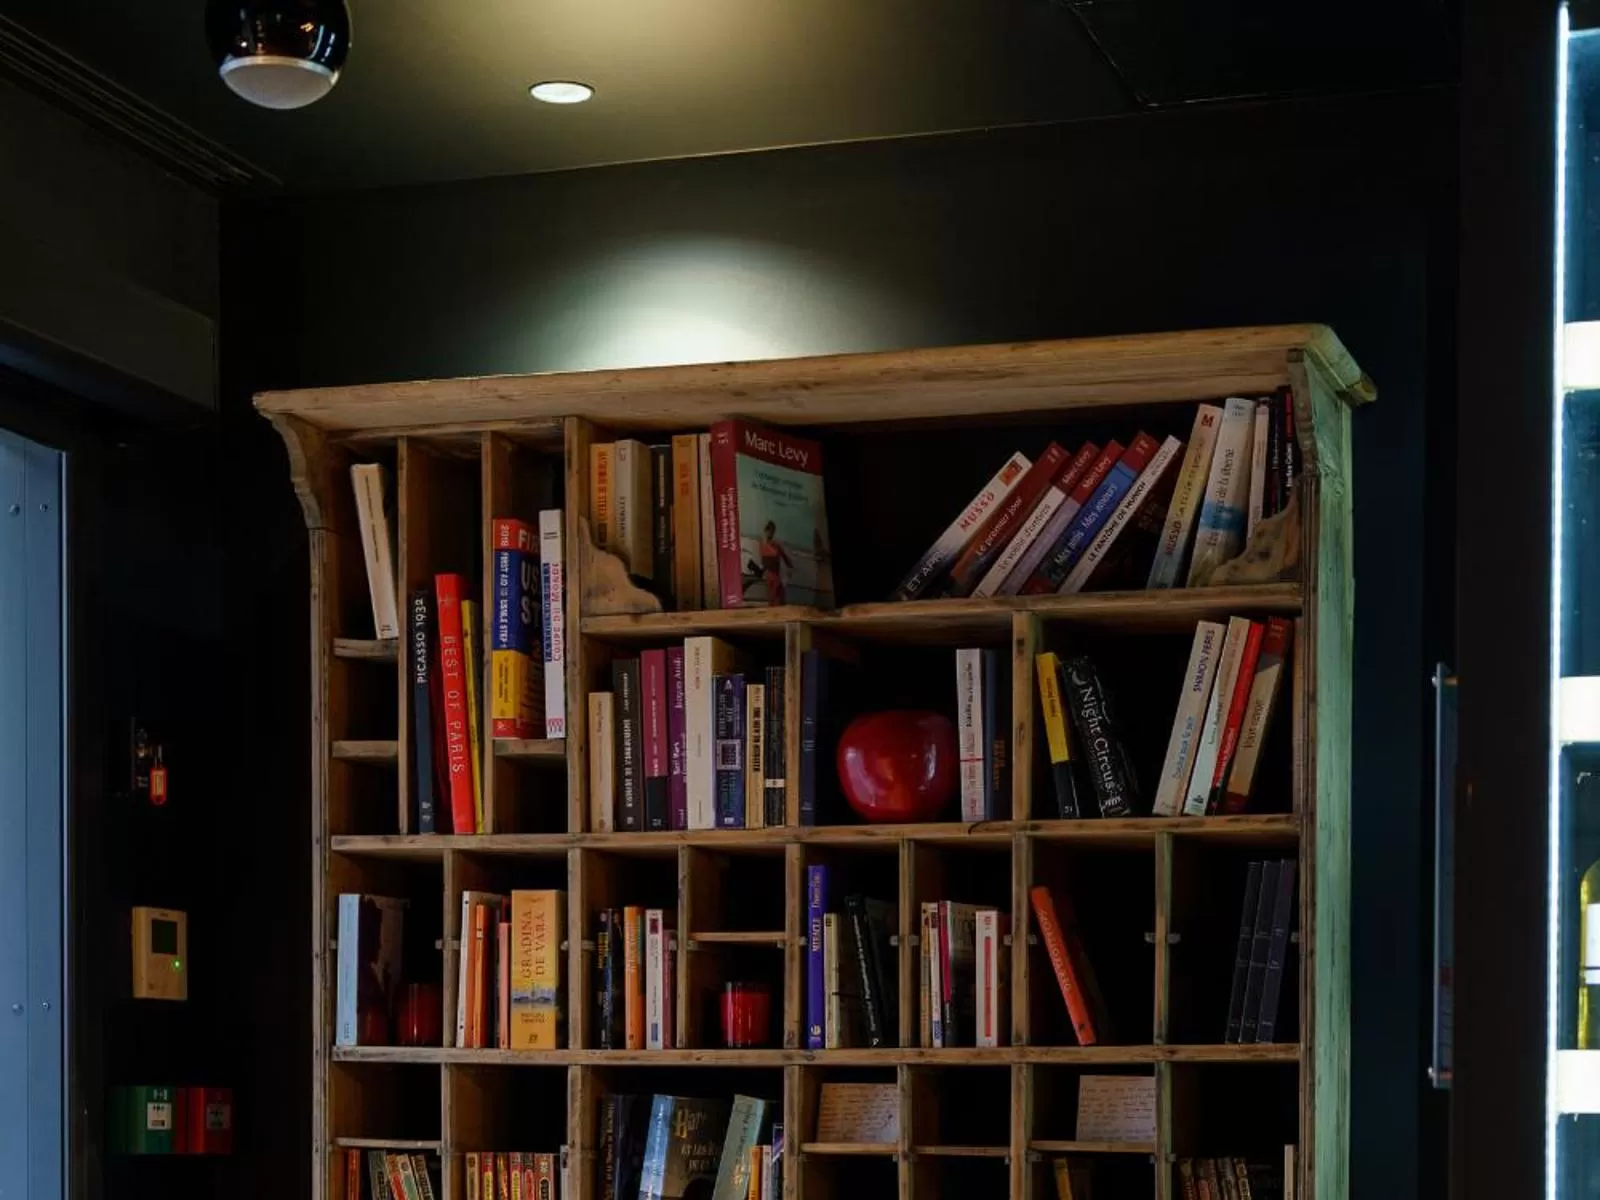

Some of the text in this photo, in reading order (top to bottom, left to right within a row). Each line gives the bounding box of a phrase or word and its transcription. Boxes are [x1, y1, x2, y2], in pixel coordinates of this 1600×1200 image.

[744, 429, 809, 467] Marc Levy
[959, 492, 995, 533] MUSSO
[415, 597, 428, 684] PICASSO 1932
[443, 635, 464, 773] BEST OF PARIS
[1080, 686, 1116, 790] Night Circus
[534, 955, 545, 976] DE
